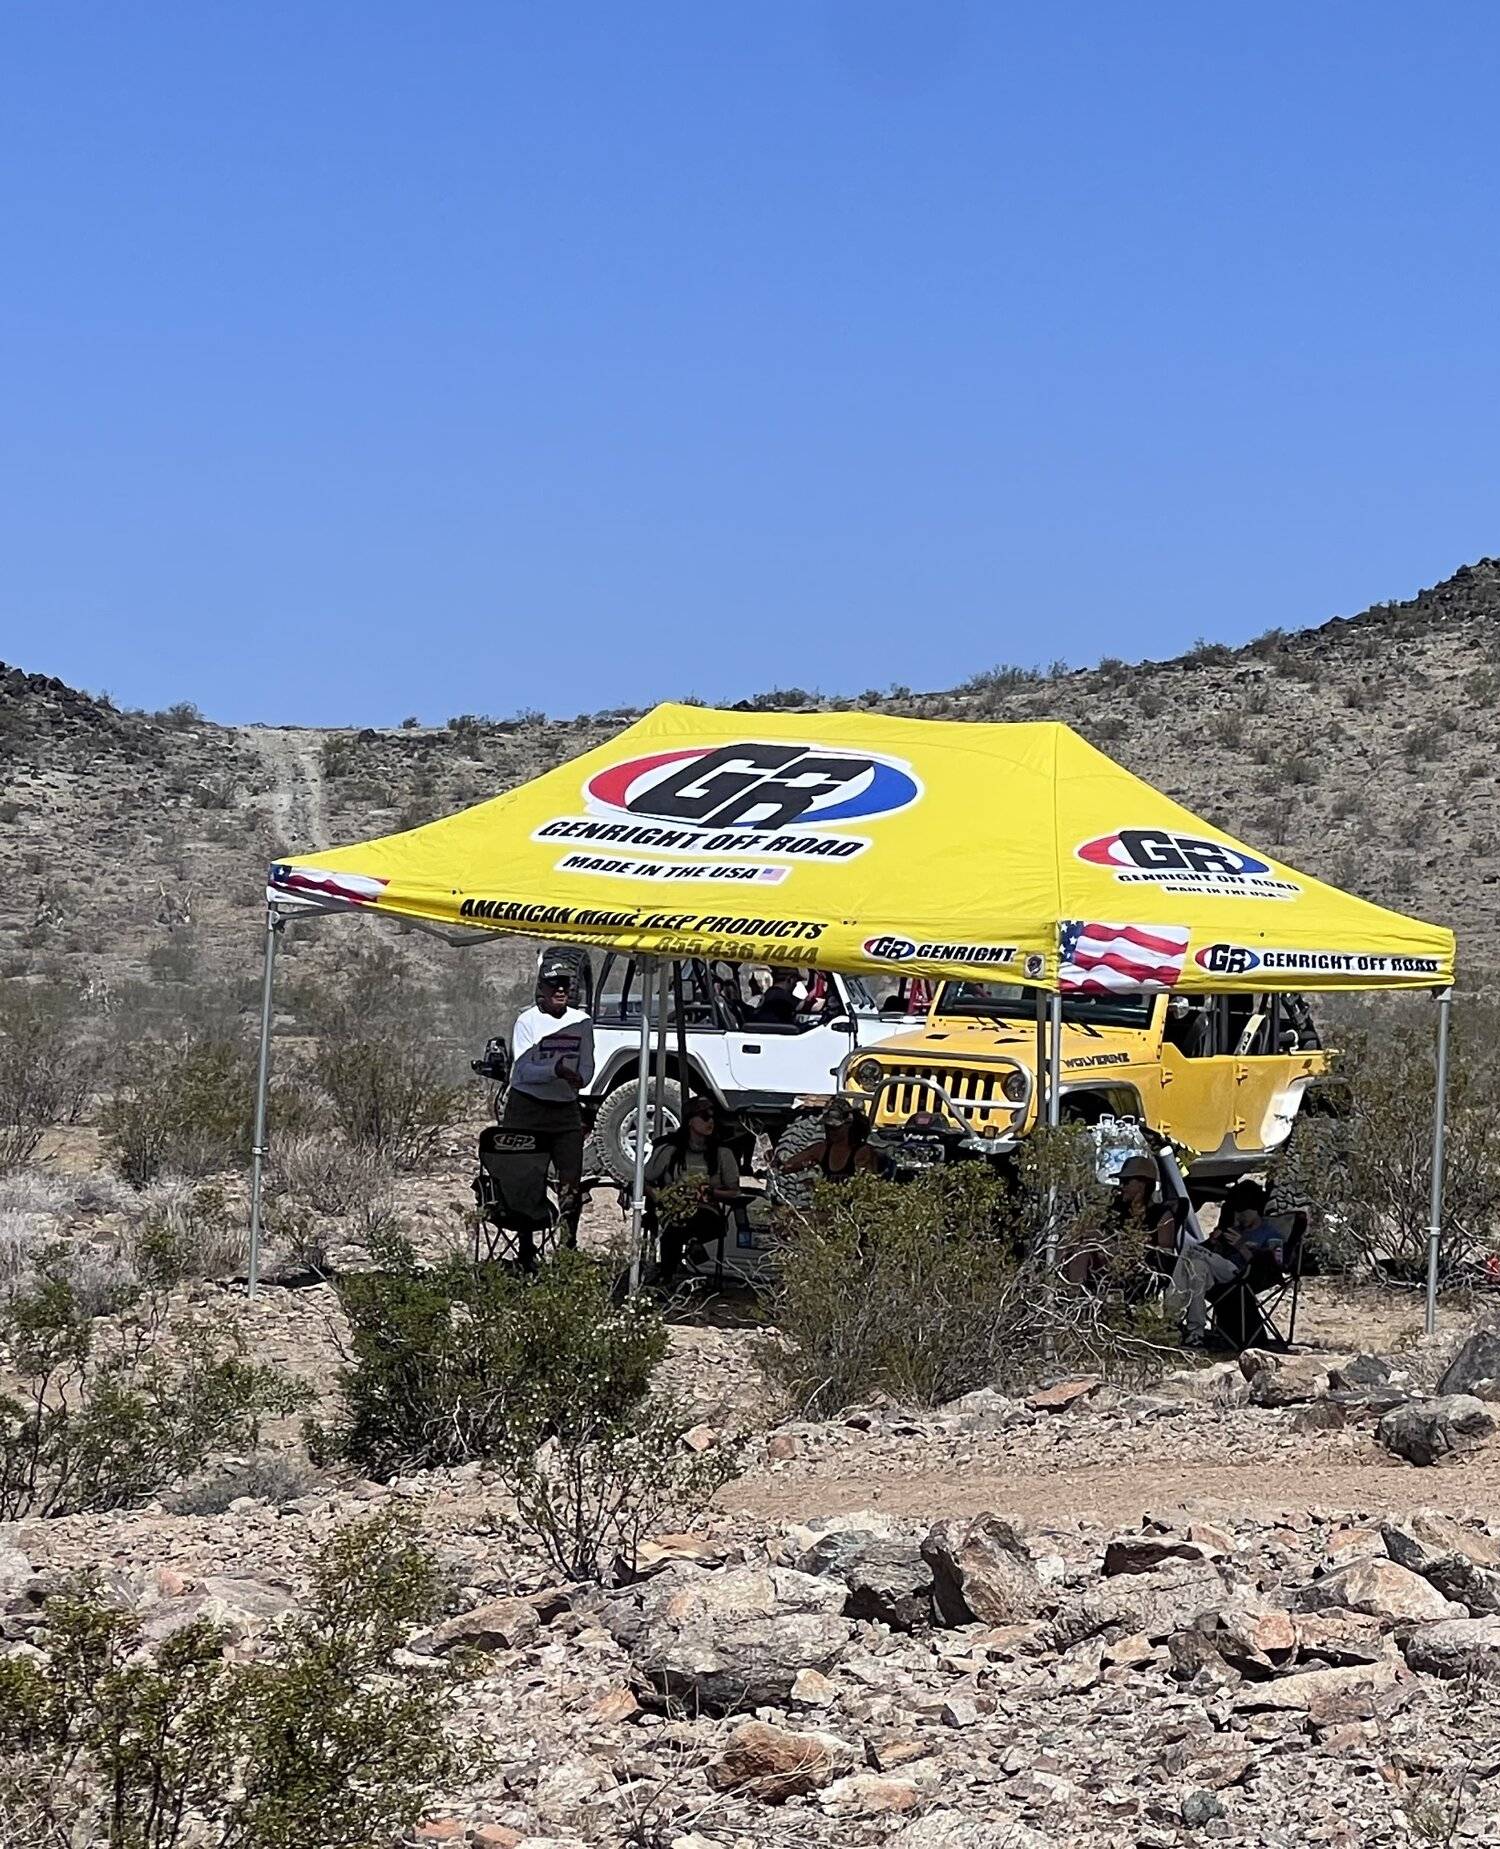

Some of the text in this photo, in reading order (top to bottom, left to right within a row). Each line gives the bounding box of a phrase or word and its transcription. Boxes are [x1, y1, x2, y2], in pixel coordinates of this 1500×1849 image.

[627, 743, 876, 830] GR
[538, 821, 865, 858] GENRIGHT OFF ROAD
[1119, 830, 1241, 875] GR
[563, 855, 759, 880] MADE IN THE USA
[1117, 872, 1301, 892] GENRIGHT OFF ROAD
[1223, 888, 1249, 897] THE
[1249, 890, 1280, 898] USA
[459, 898, 578, 924] AMERICAN
[692, 915, 829, 940] PRODUCTS
[653, 935, 820, 964] 855.436.7444
[916, 944, 1017, 962] GENRIGHT
[1209, 943, 1438, 974] GR GENRIGHT OFF ROAD
[1062, 1052, 1131, 1069] WOLVERINE
